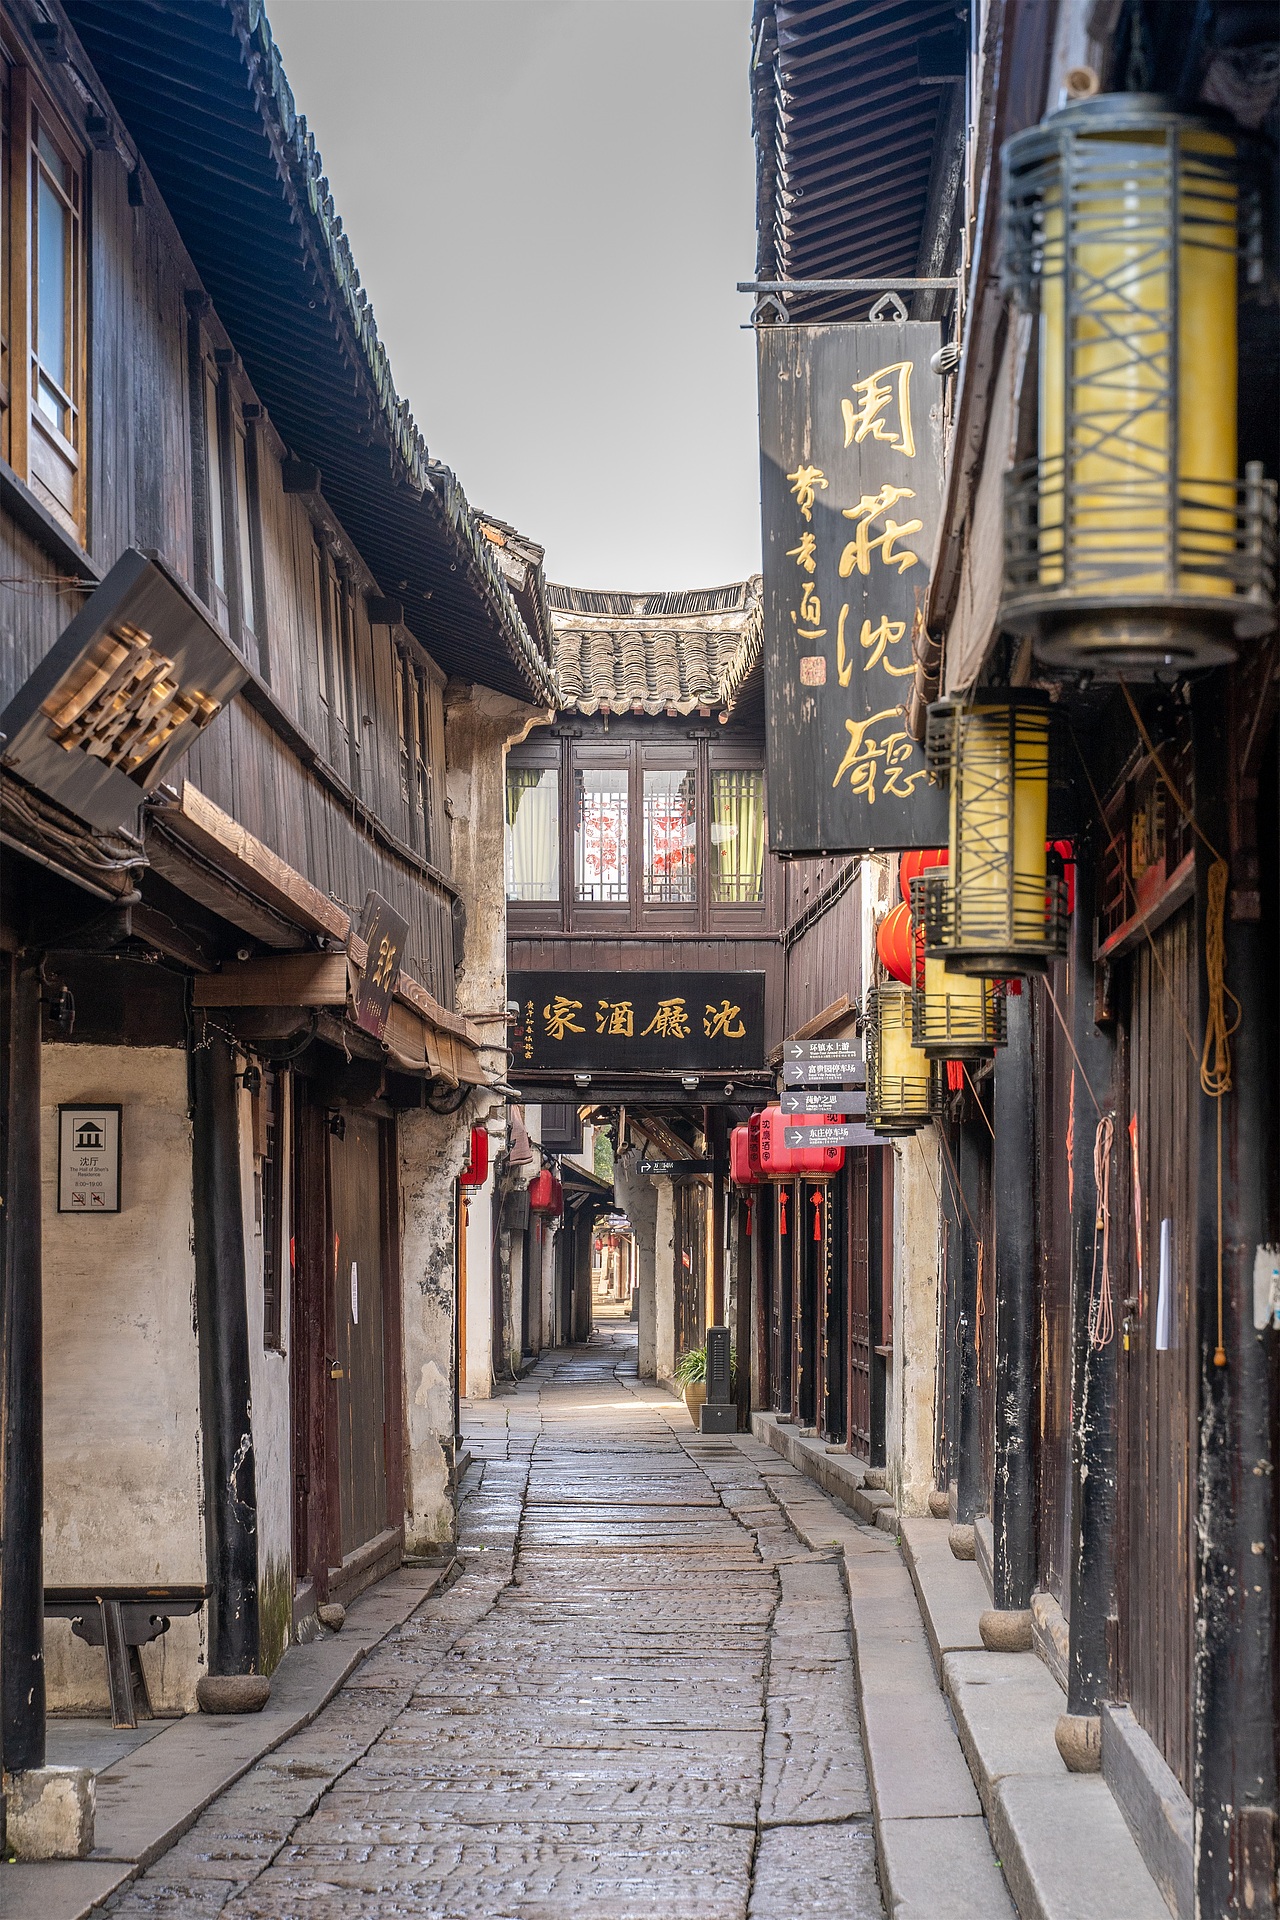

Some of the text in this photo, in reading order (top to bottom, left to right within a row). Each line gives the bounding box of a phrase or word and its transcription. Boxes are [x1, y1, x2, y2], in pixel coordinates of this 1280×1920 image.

[542, 995, 746, 1041] 沈廳酒家
[809, 1042, 850, 1052] 环镇水上游
[807, 1064, 856, 1074] 富贵园停车场
[809, 1127, 849, 1138] 东庄停车场
[80, 1156, 99, 1166] 沈厅
